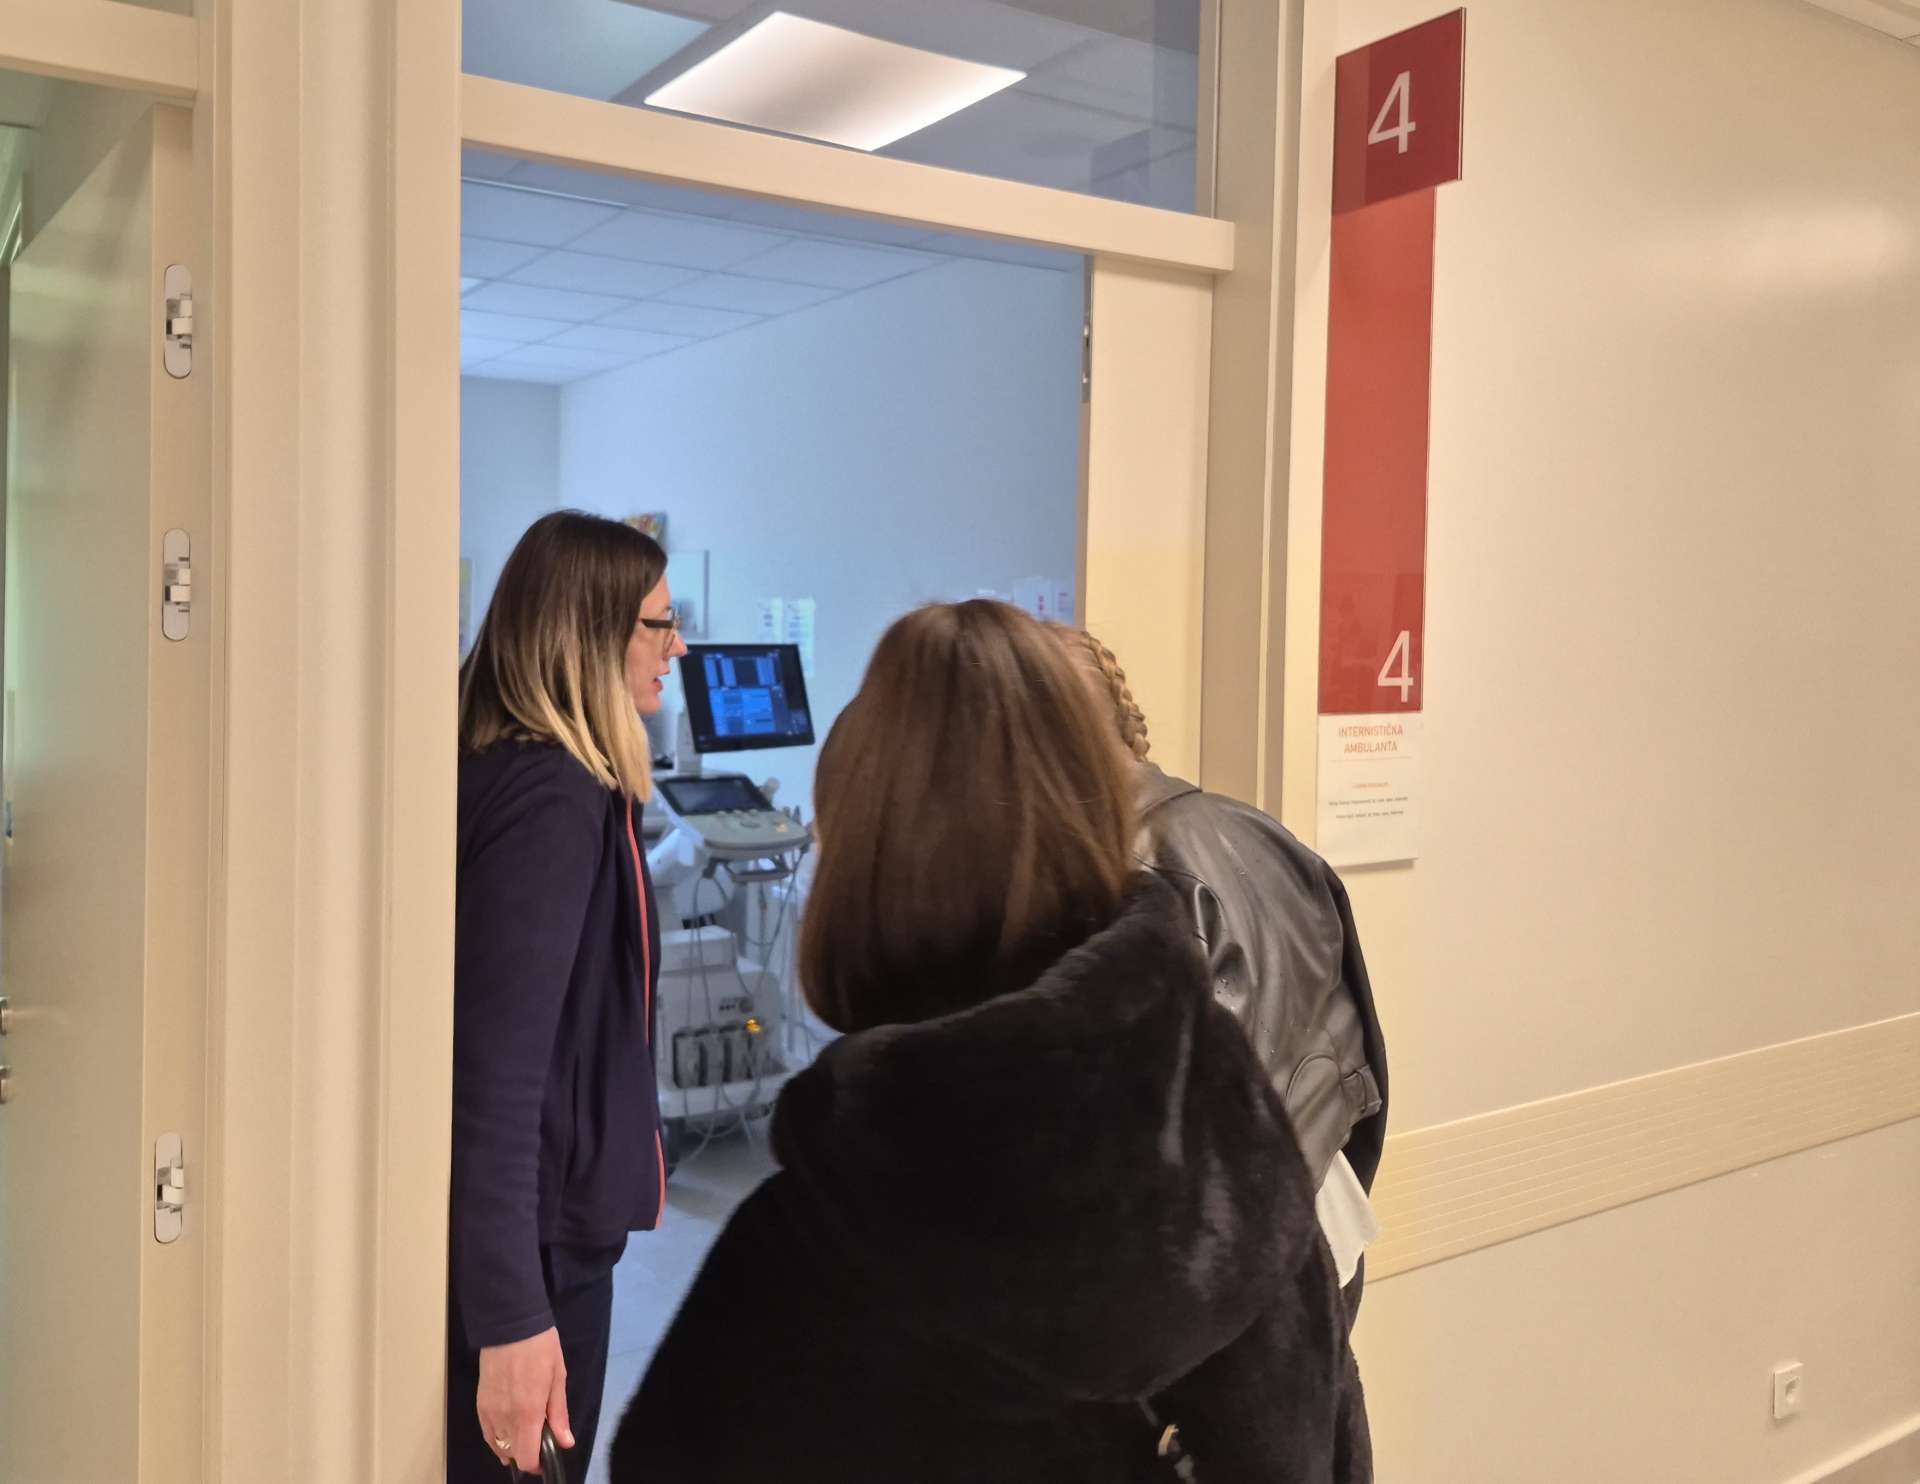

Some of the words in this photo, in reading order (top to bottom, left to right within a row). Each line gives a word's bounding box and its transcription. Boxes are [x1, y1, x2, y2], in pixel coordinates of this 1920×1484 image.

[1367, 71, 1416, 154] 4
[1377, 630, 1414, 703] 4
[1338, 723, 1404, 737] INTERNISTIČKA
[1344, 740, 1398, 753] AMBULANTA
